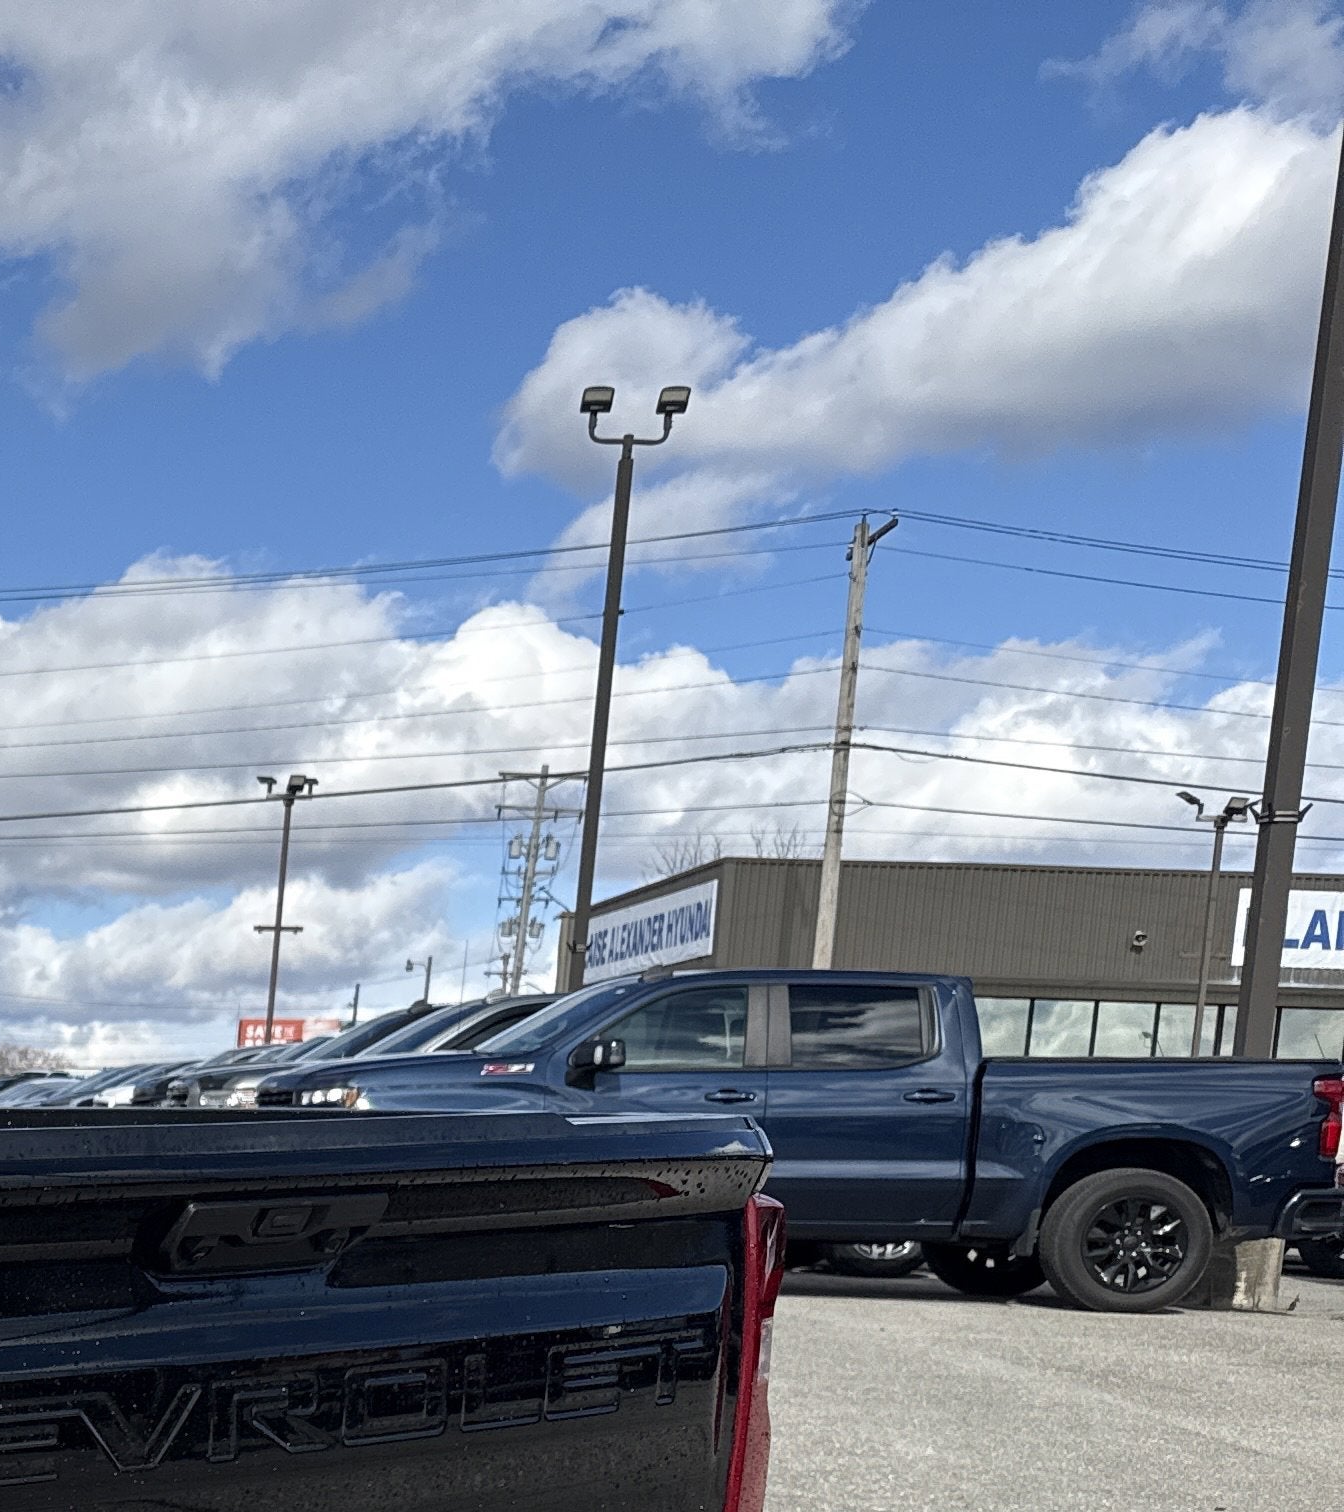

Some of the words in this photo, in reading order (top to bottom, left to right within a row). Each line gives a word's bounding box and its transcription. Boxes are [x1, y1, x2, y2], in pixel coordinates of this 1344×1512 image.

[607, 912, 665, 963] ALEXANDER
[665, 899, 712, 948] HYUNDAI
[245, 1025, 283, 1038] SAE
